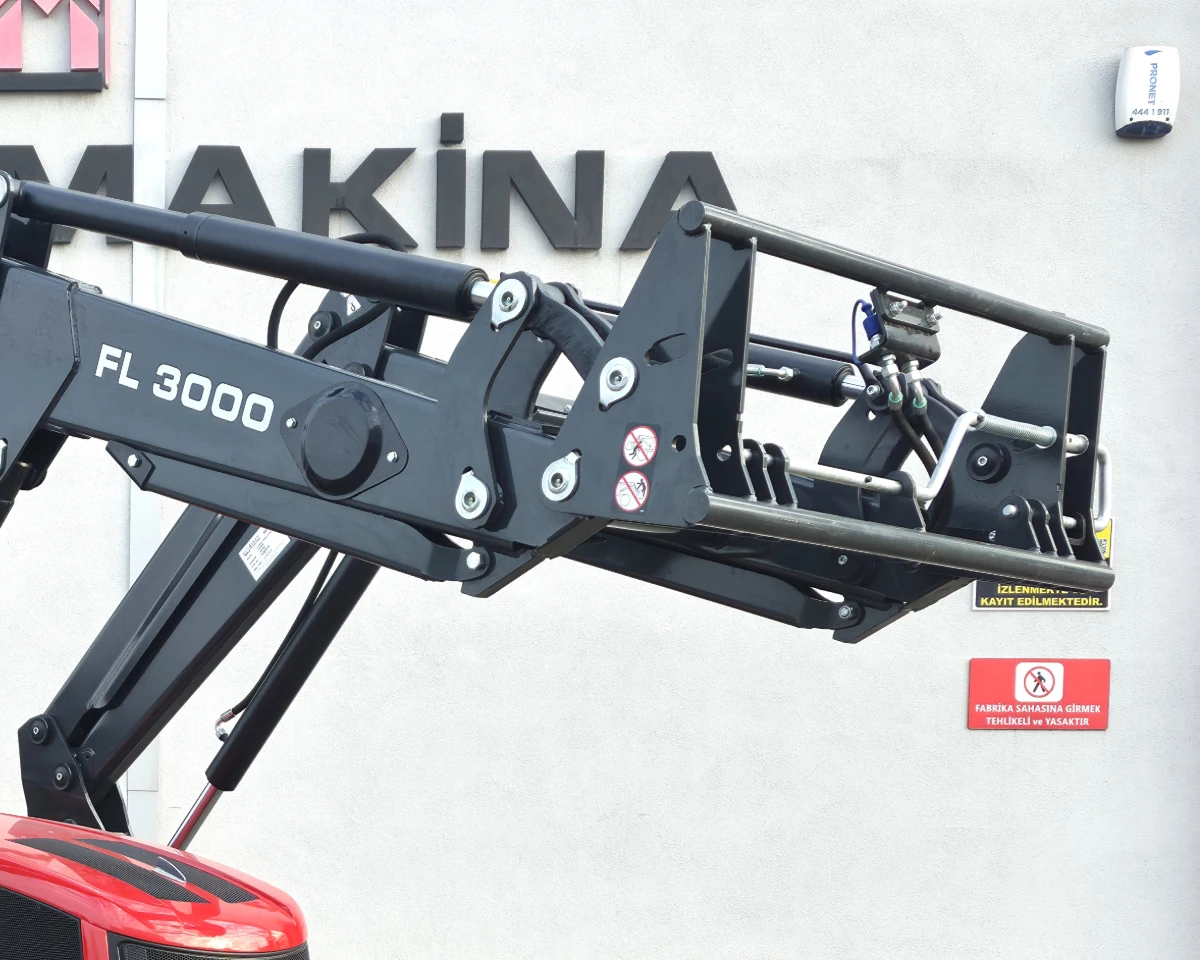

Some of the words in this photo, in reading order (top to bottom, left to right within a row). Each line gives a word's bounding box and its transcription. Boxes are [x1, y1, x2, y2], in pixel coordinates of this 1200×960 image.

[1148, 63, 1158, 105] PRONET
[1132, 108, 1149, 116] 444
[1157, 108, 1170, 116] 911
[95, 343, 140, 390] FL
[152, 363, 276, 433] 3000
[980, 597, 1014, 606] KAYIT
[1017, 595, 1103, 606] EDİLMEKTEDİR.
[975, 702, 1014, 713] FABRİKA
[1016, 704, 1063, 713] SAHASINA
[1065, 703, 1101, 713] GİRMEK
[986, 715, 1031, 726] TEHLİKELİ
[1046, 717, 1089, 726] YASAKTIR
